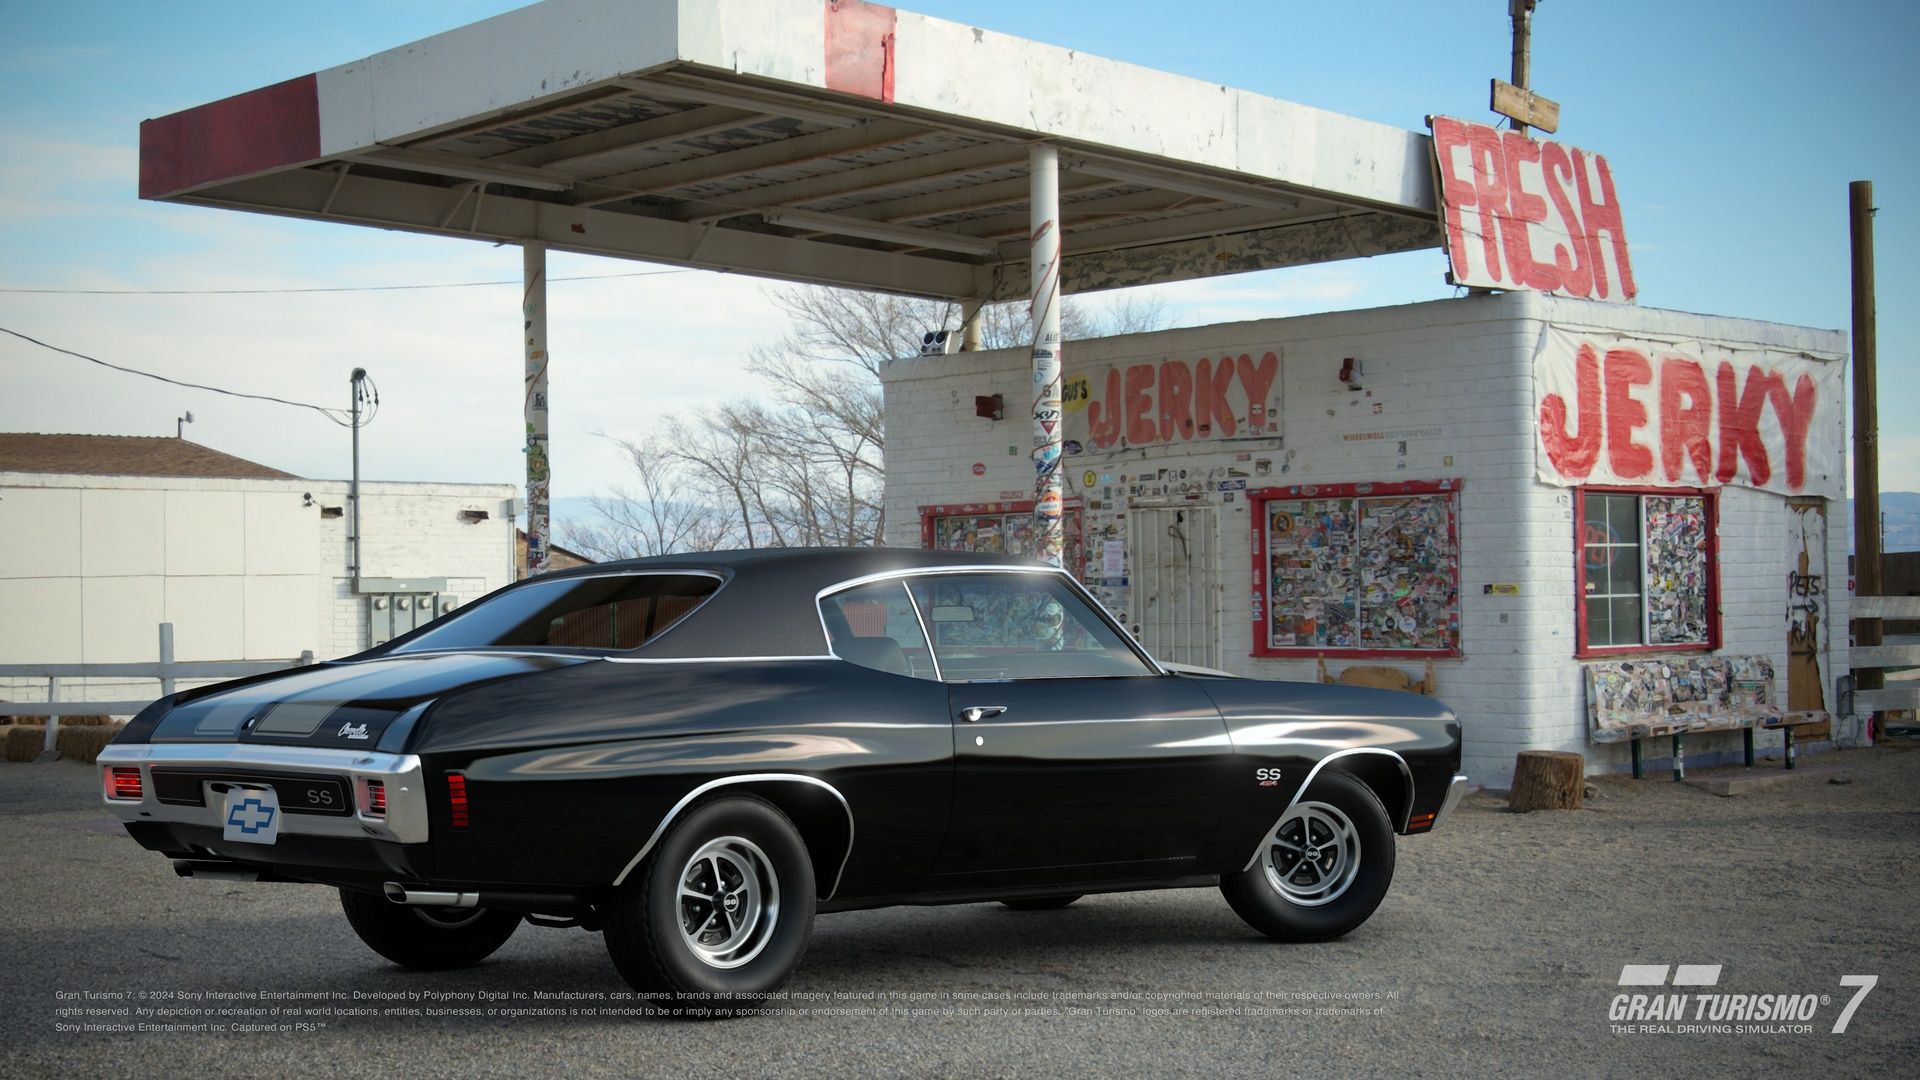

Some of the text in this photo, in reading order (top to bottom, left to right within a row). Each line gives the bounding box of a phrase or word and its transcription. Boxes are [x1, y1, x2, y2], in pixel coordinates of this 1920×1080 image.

[1434, 117, 1636, 300] FRESH
[1088, 351, 1279, 449] JERKY
[1540, 344, 1818, 491] JERKY
[307, 789, 333, 805] SS
[1256, 768, 1281, 781] SS
